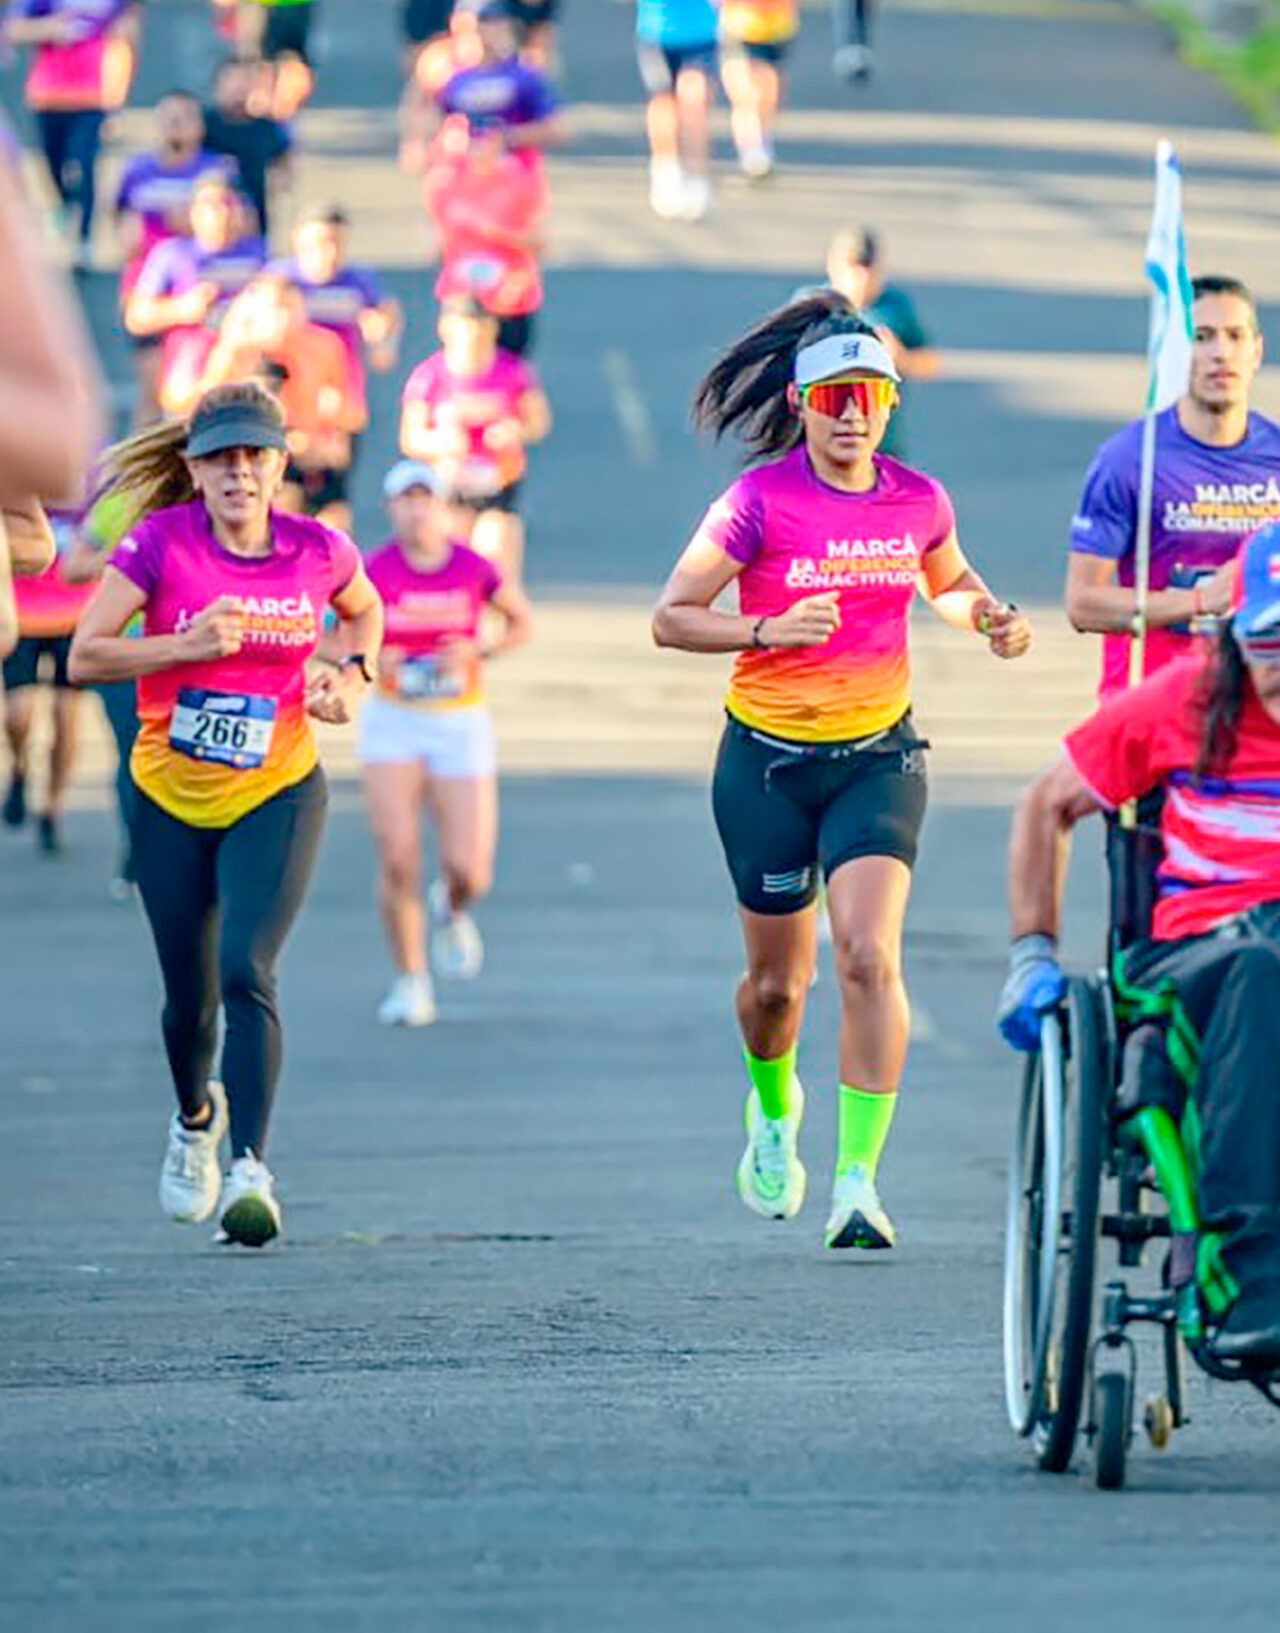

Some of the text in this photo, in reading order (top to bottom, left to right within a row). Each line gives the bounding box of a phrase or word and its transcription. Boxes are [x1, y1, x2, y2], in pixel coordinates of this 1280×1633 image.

[826, 532, 917, 558] MARCÁ
[219, 590, 314, 616] ARCÁ
[193, 713, 247, 748] 266
